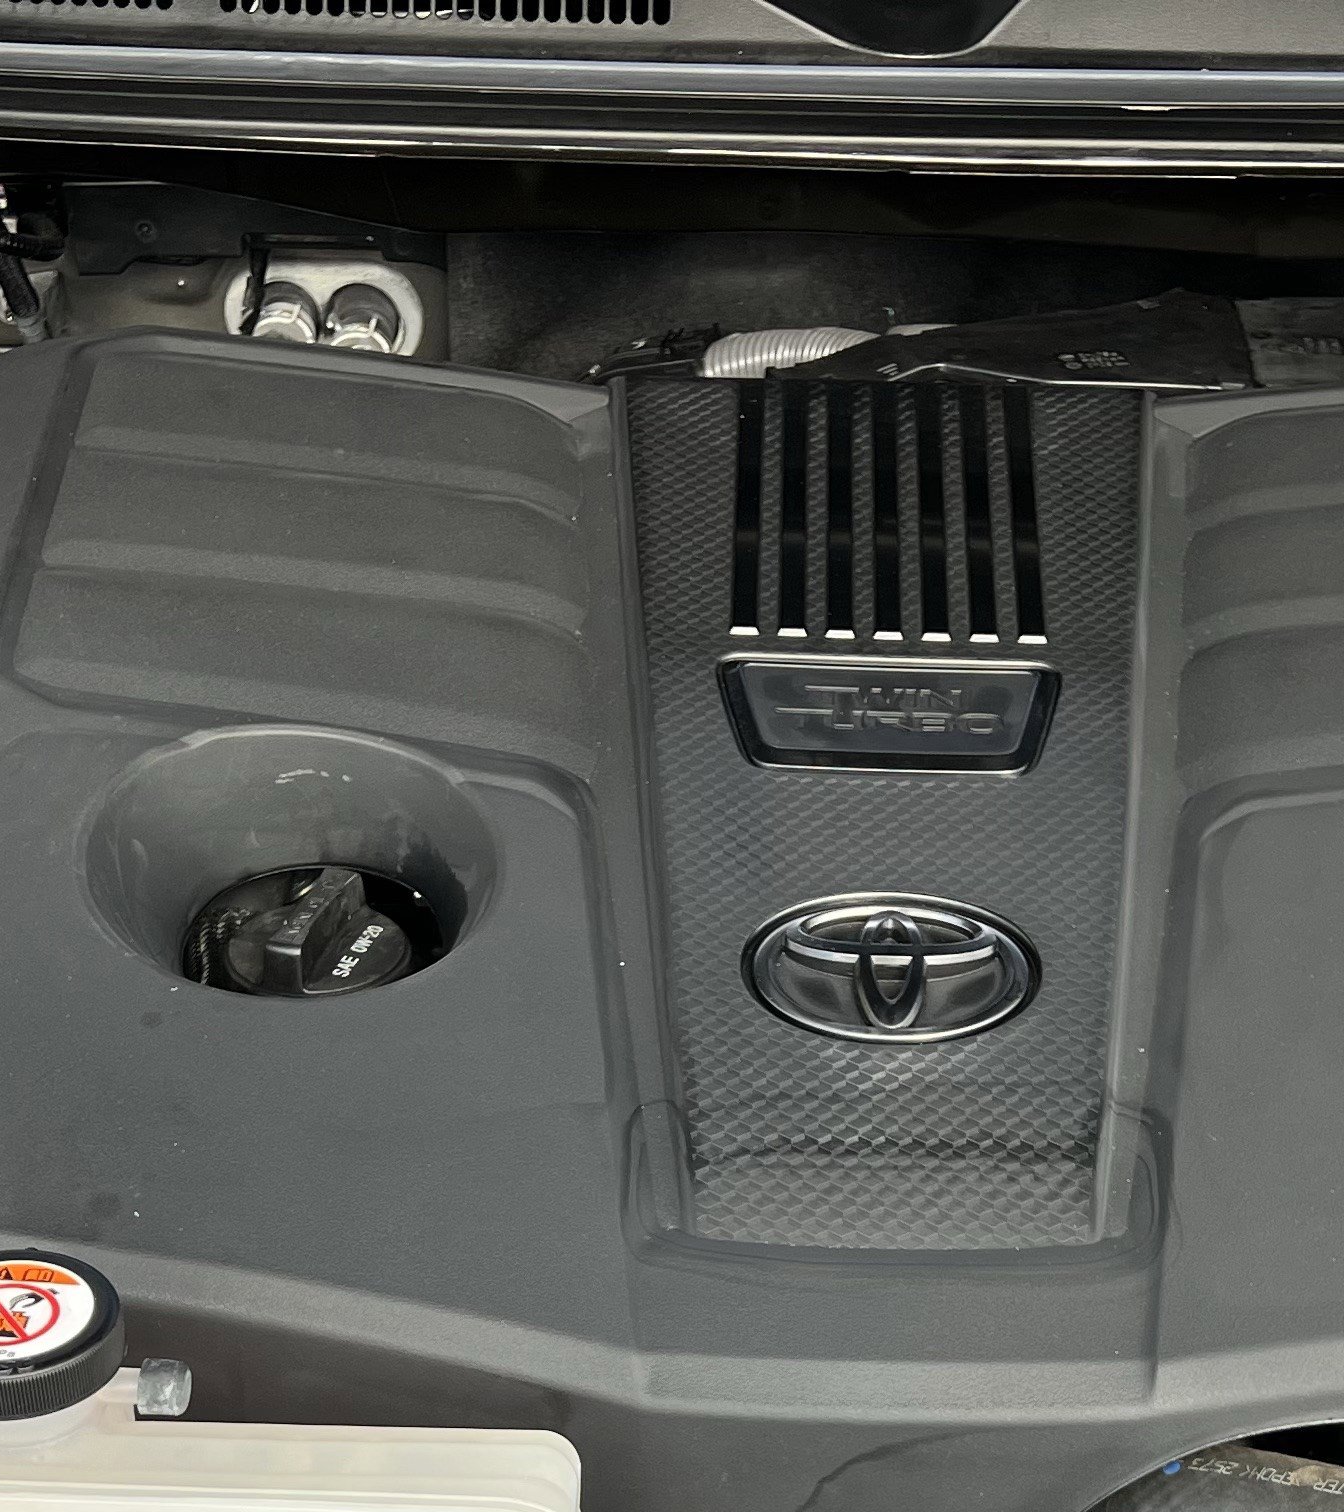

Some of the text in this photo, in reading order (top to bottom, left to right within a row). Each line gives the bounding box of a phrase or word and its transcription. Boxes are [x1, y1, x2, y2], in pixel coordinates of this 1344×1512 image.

[804, 684, 962, 712] TWIN
[774, 706, 1005, 735] TURBO
[332, 924, 384, 979] SAE 0W-20
